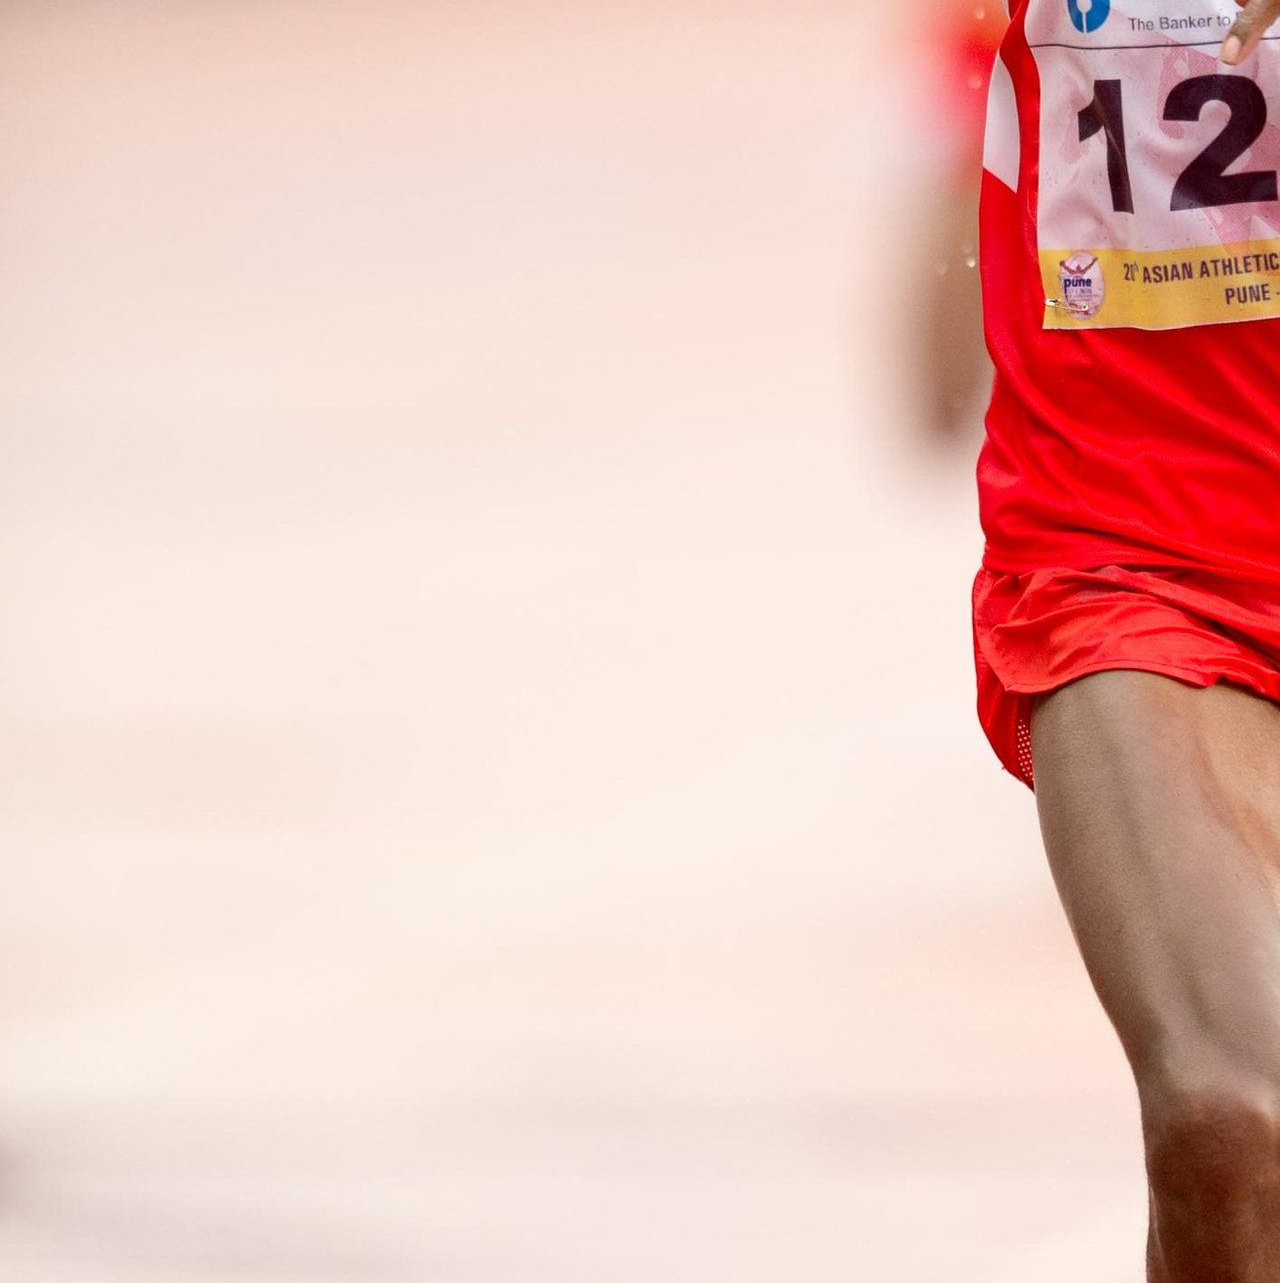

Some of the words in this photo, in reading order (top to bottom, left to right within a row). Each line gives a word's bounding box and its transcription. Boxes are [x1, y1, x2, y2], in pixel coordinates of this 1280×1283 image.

[1128, 17, 1154, 31] The
[1159, 15, 1213, 30] Banker
[1216, 15, 1231, 27] to
[1143, 262, 1193, 283] ASIAN
[1063, 277, 1092, 297] pune
[1225, 283, 1270, 305] PUNE
